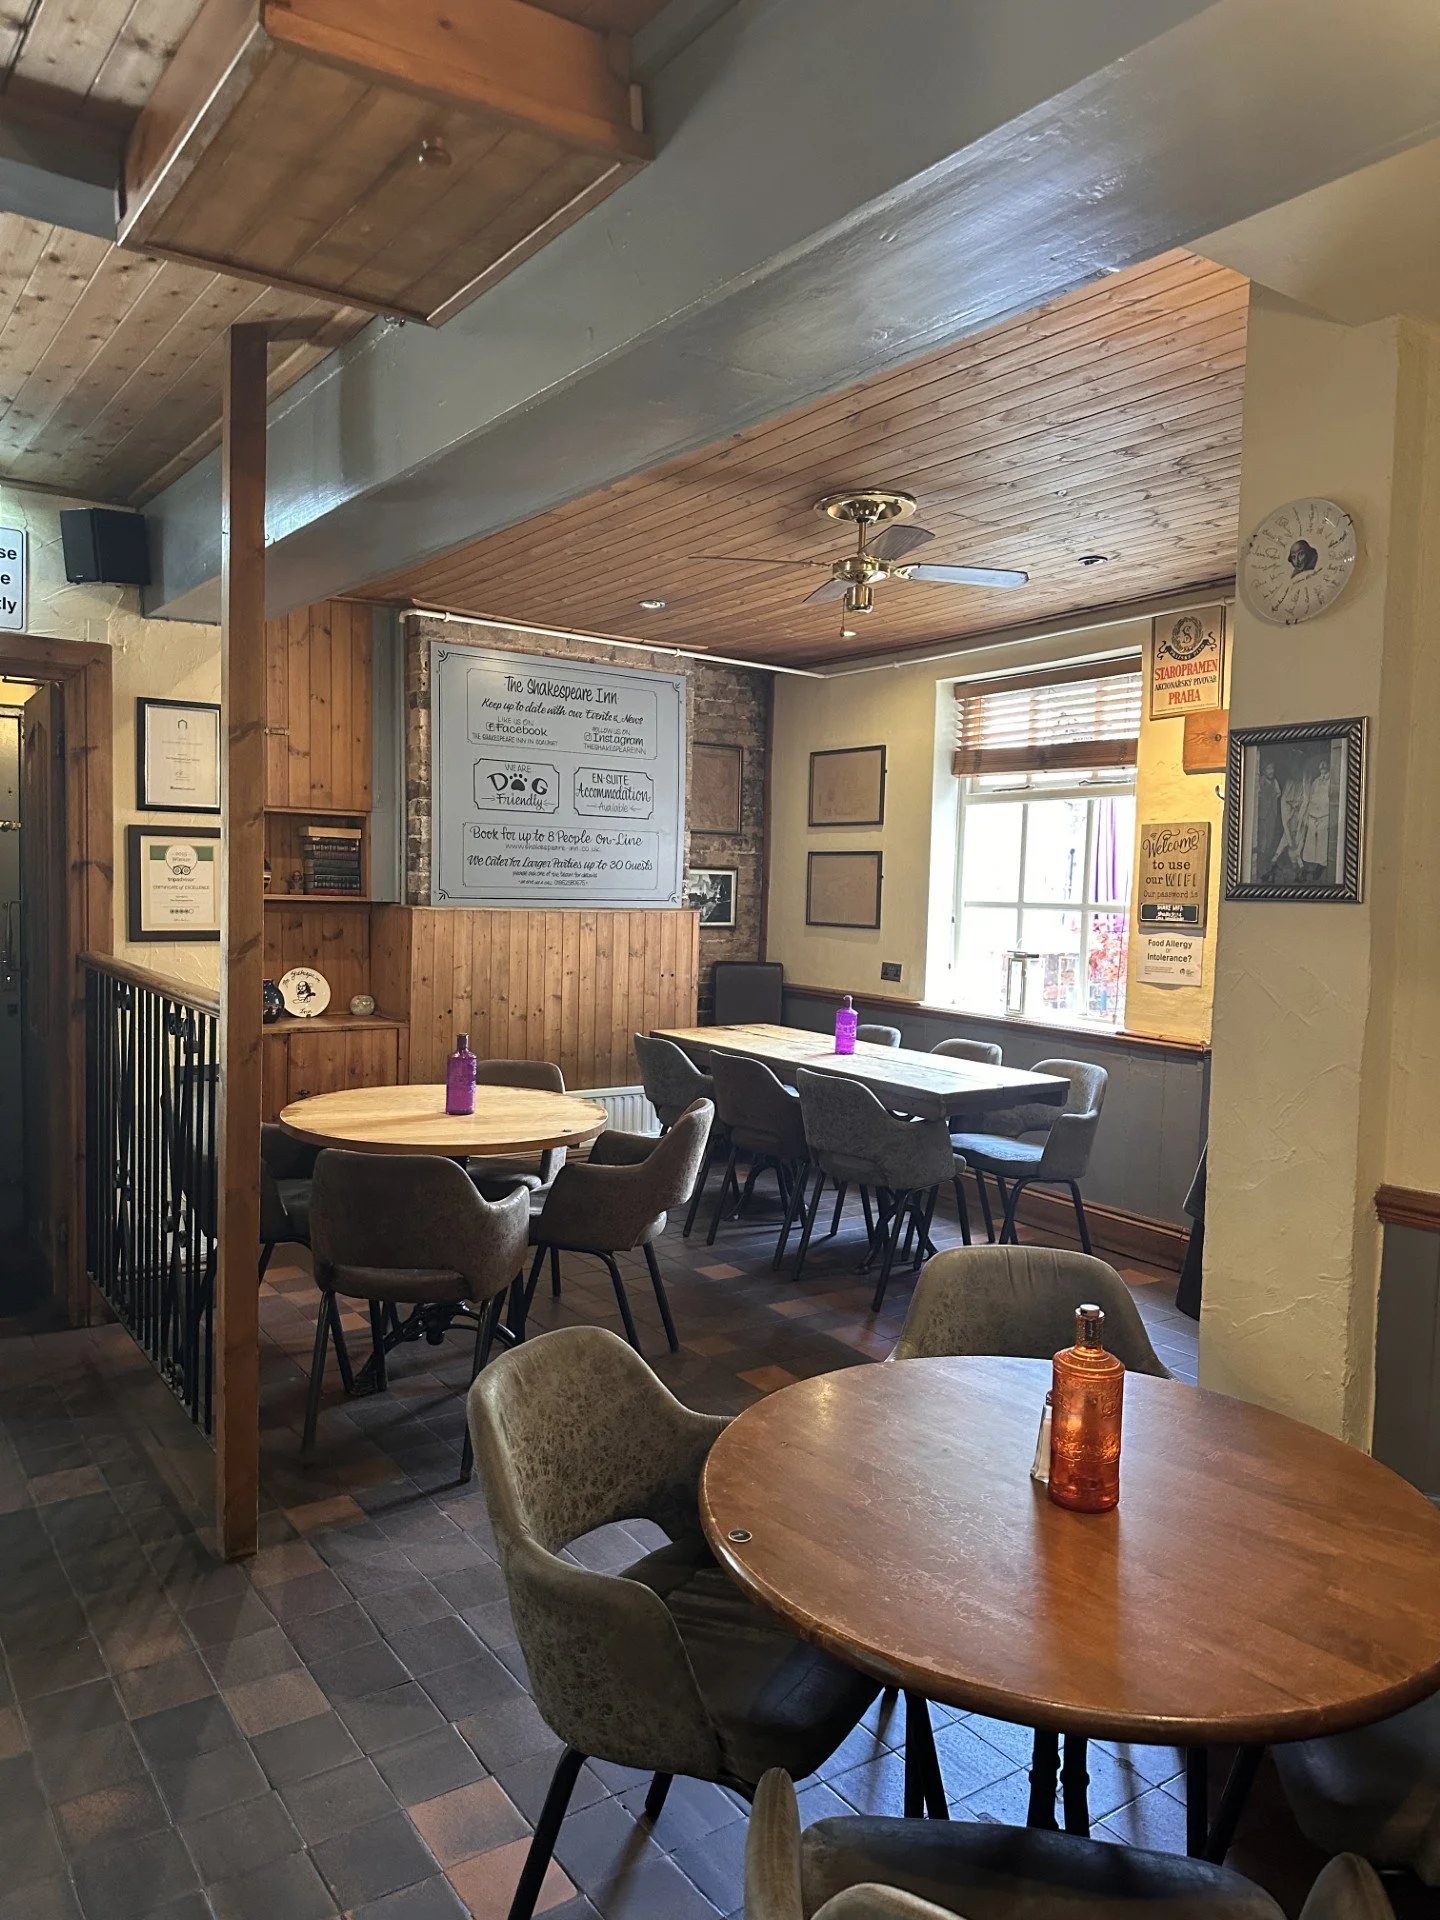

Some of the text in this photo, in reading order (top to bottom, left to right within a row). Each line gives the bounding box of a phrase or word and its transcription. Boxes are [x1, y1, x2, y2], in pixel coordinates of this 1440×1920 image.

[1154, 659, 1218, 681] STAROPRAMEN
[504, 675, 618, 704] The Shakespeare Inn
[1168, 689, 1202, 705] PRAHA
[481, 698, 502, 711] Keep
[503, 703, 514, 713] up
[514, 701, 524, 711] to
[524, 701, 546, 714] date
[547, 705, 567, 715] with
[568, 709, 583, 718] our
[585, 709, 613, 721] Events
[621, 714, 643, 724] News
[495, 723, 548, 736] Facebook
[592, 732, 644, 746] Instagram
[517, 765, 531, 773] ARE
[592, 773, 629, 786] EN-SUITE
[575, 782, 652, 802] Accommodation
[496, 793, 546, 811] Friendly
[470, 826, 499, 840] Book
[501, 826, 515, 841] for
[518, 832, 532, 845] up
[533, 829, 545, 842] to
[547, 831, 555, 842] 8
[556, 829, 592, 845] People
[1143, 828, 1206, 858] Welcome
[467, 855, 653, 871] We Cater for Larger Parties up to 30 Guests
[1152, 861, 1191, 870] to use
[1146, 876, 1163, 884] our
[1143, 889, 1199, 899] Our password is
[1148, 939, 1193, 950] Food Allergy
[1147, 953, 1192, 963] Intolerance?
